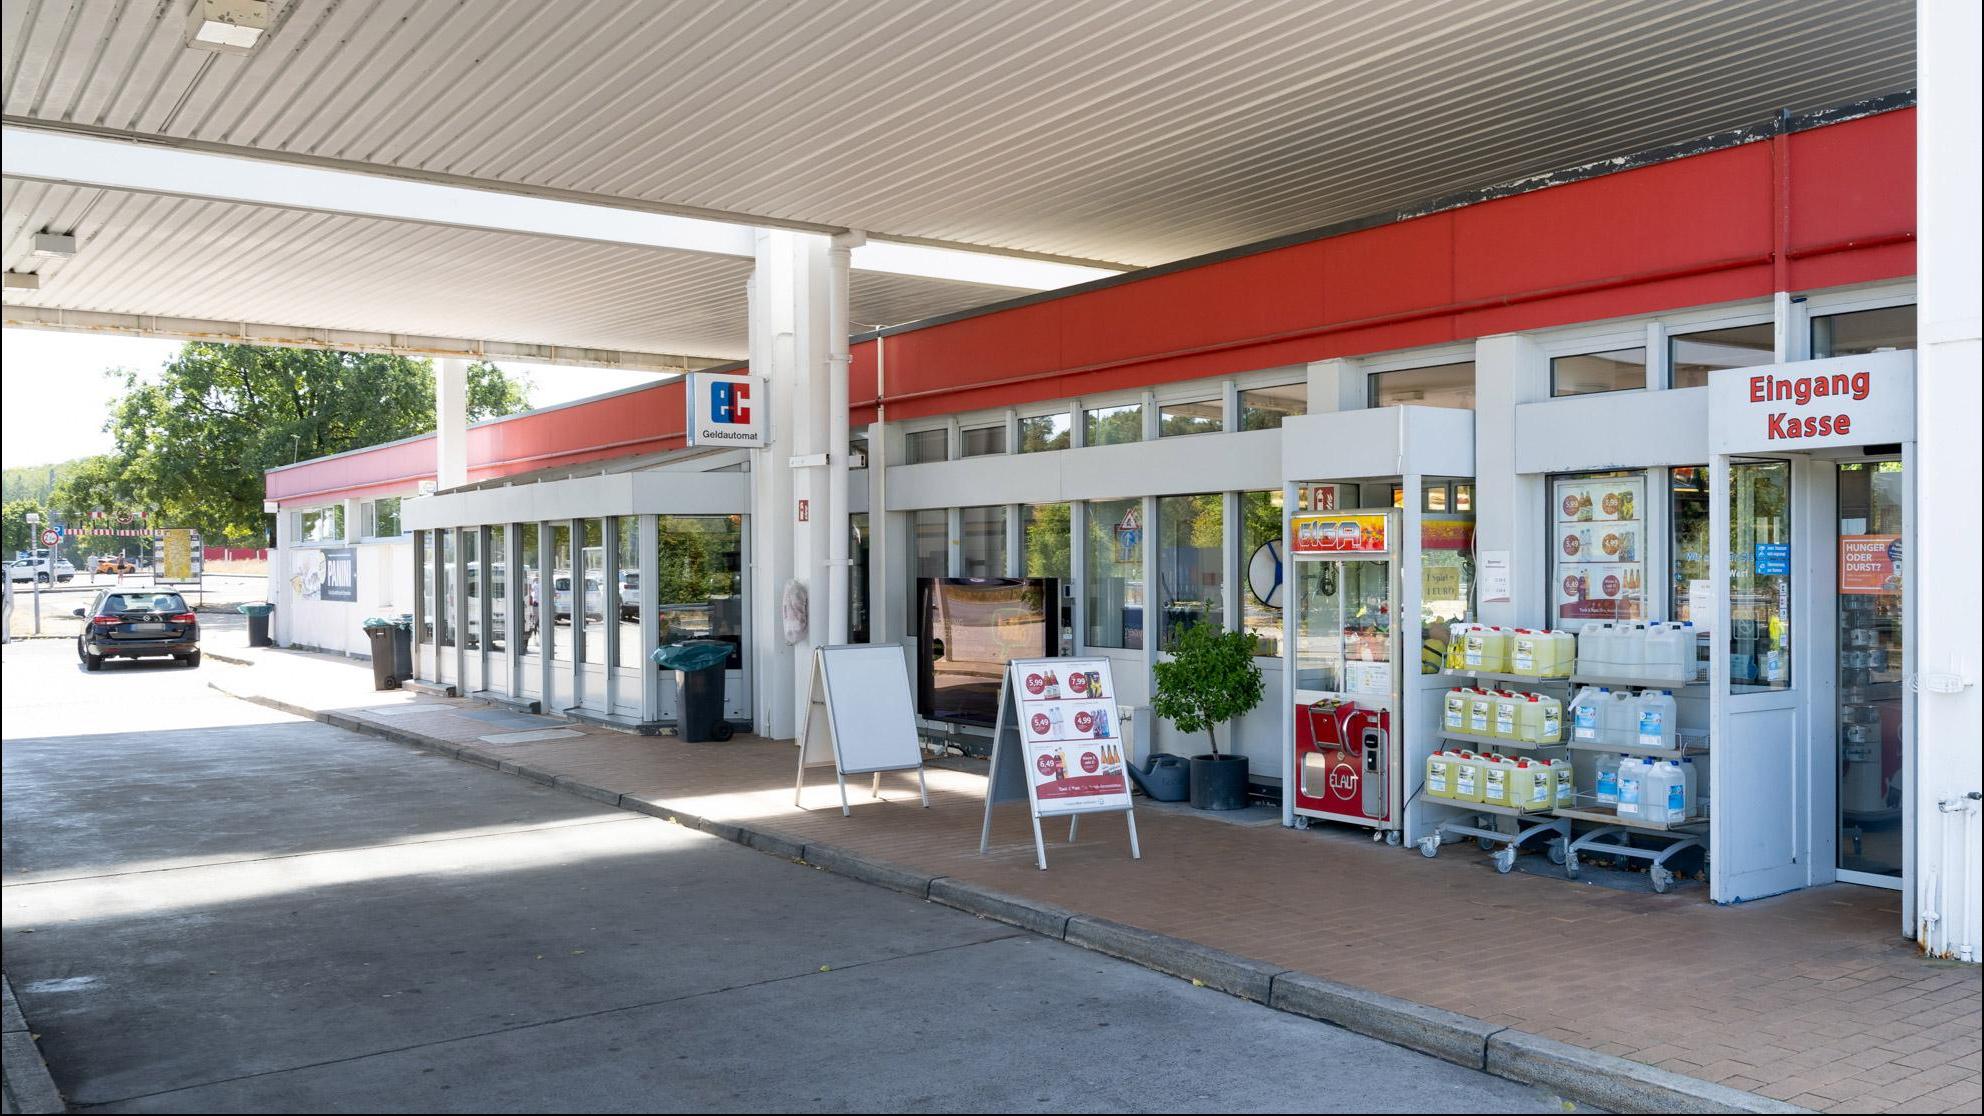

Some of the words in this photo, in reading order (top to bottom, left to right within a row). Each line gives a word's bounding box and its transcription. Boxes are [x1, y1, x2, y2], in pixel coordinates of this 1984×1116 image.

[1750, 371, 1870, 405] Eingang
[1768, 412, 1850, 440] Kasse
[702, 429, 758, 440] Geldautomat
[1846, 543, 1886, 552] HUNGER
[1846, 553, 1873, 562] ODER
[1846, 563, 1882, 572] DURST?
[1330, 774, 1359, 789] ELAUT
